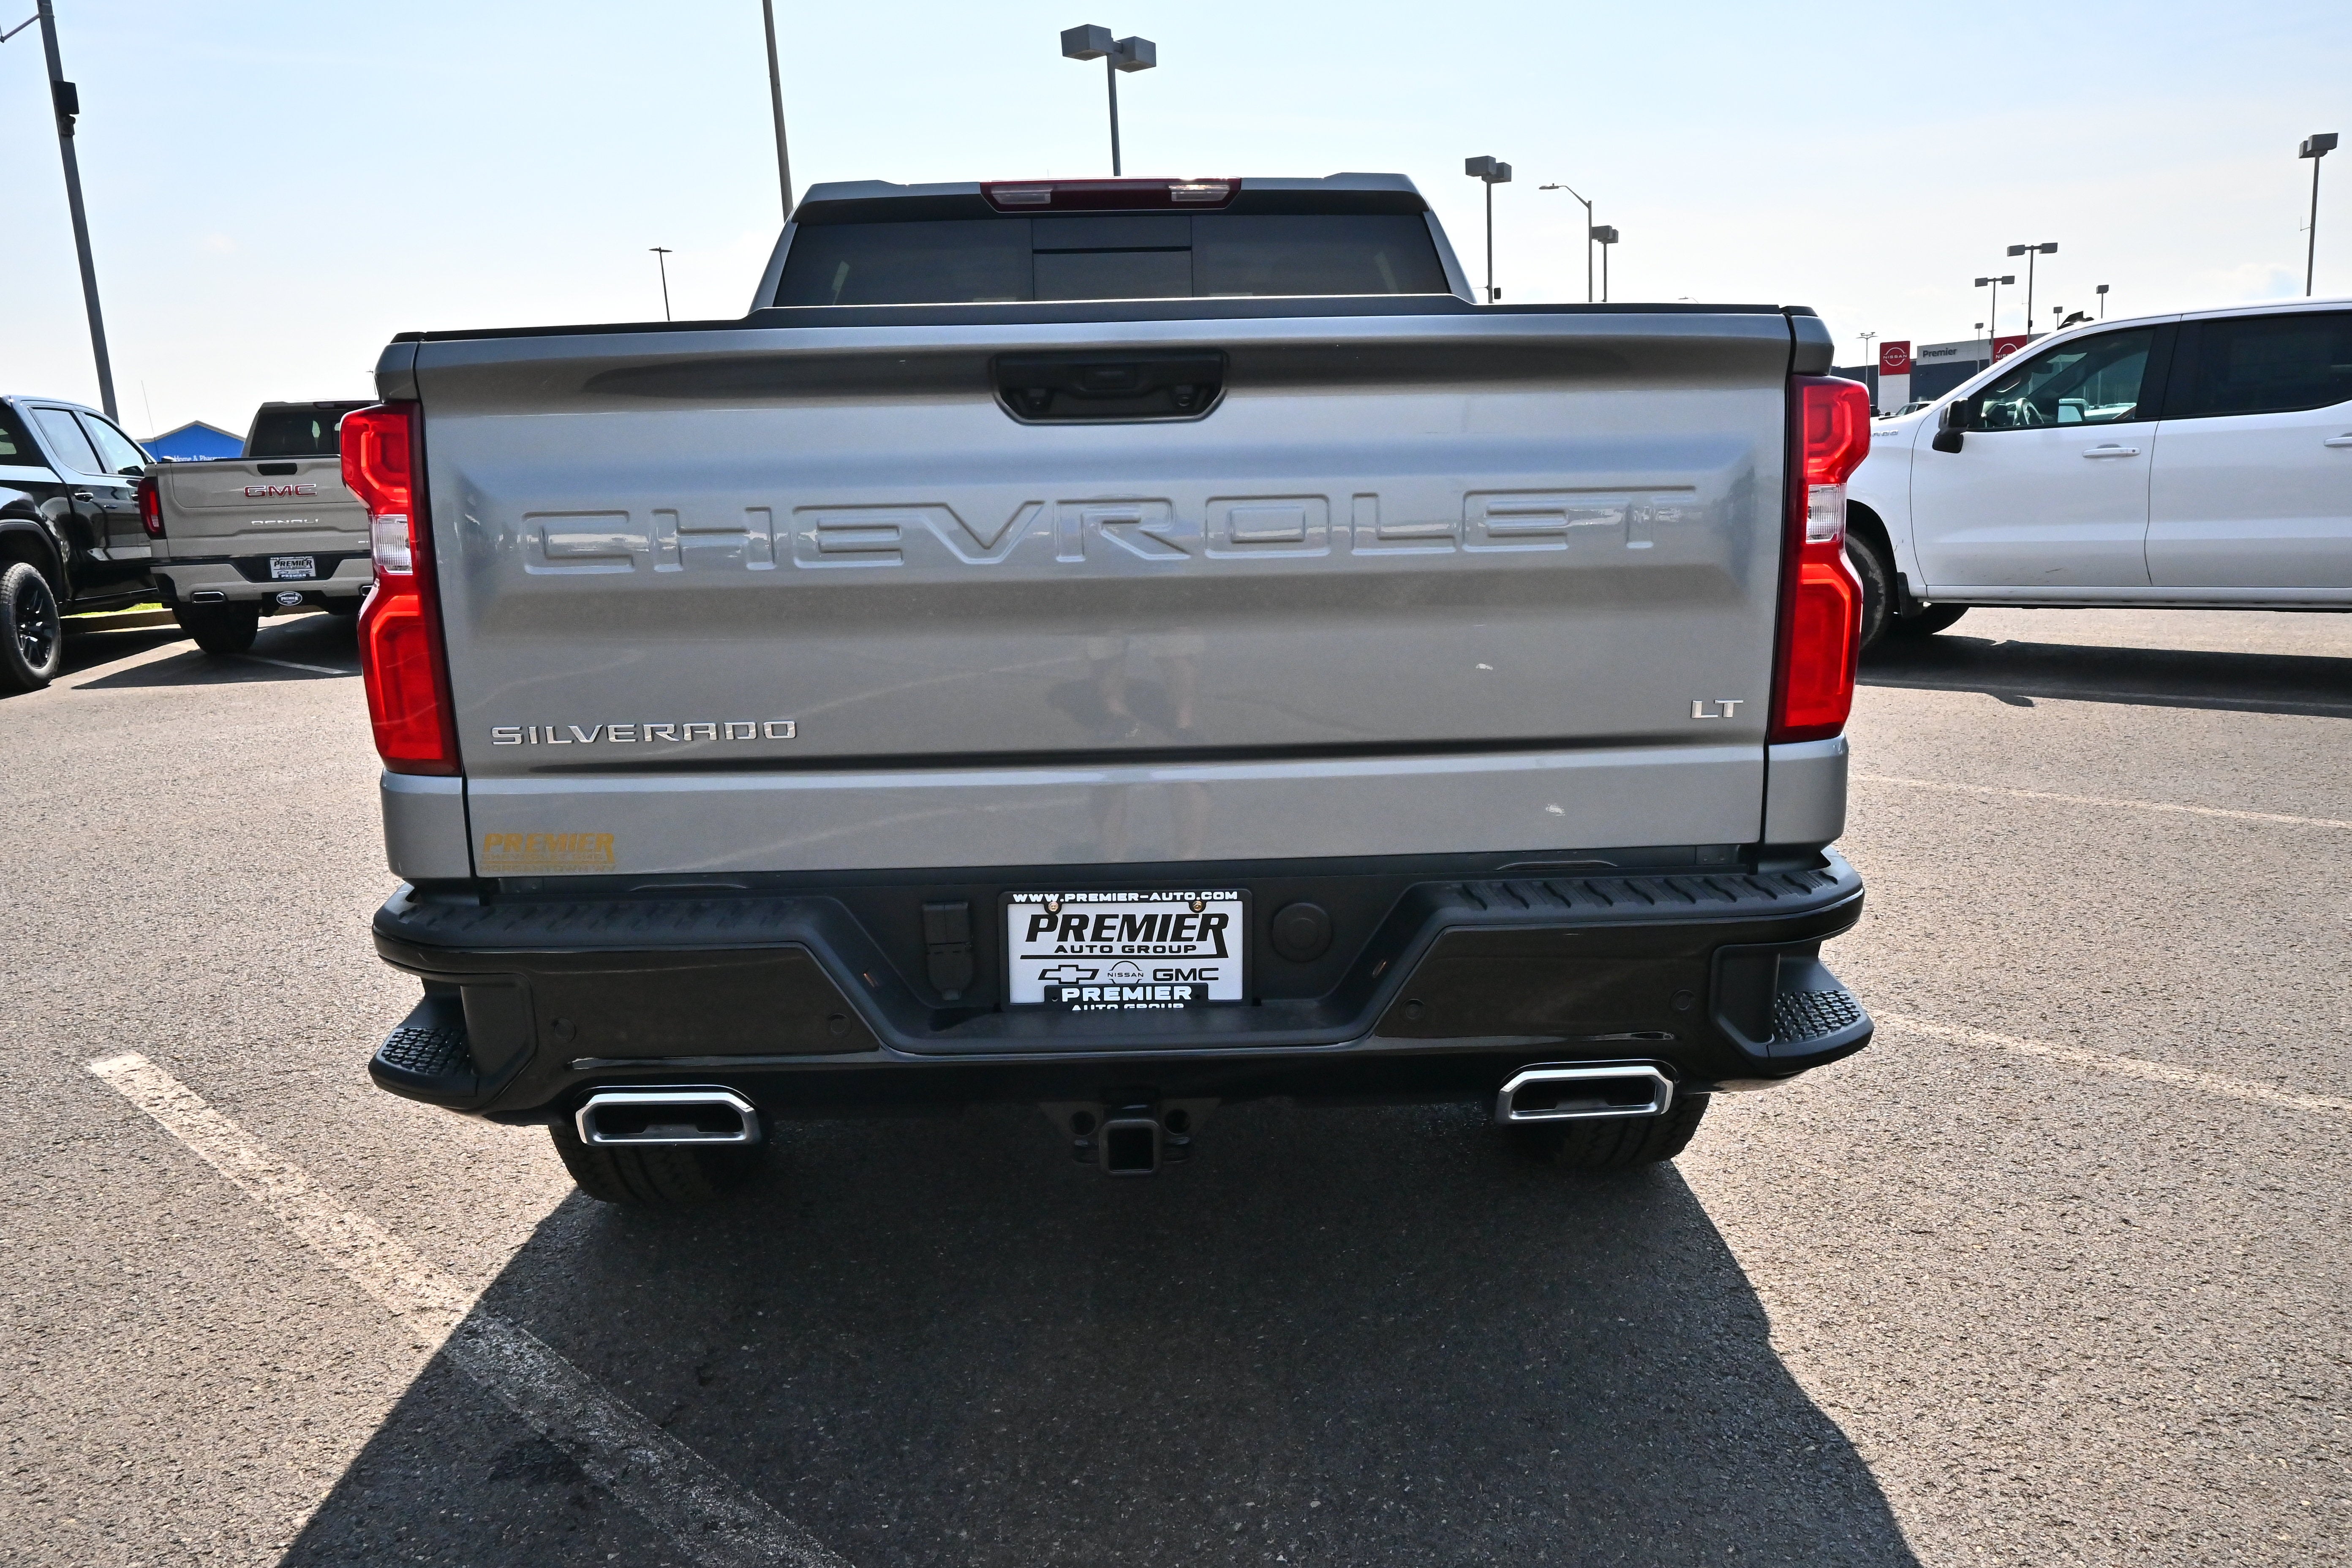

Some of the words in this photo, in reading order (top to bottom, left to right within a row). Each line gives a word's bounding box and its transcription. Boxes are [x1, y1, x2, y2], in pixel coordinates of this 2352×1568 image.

[1922, 347, 1958, 358] Premier
[244, 483, 317, 498] GMC
[520, 485, 1697, 574] CHEVROLET
[274, 560, 313, 569] PREMIER
[1690, 699, 1744, 719] LT
[491, 720, 797, 746] SILVERADO
[483, 833, 615, 863] PREMIER
[1013, 891, 1238, 903] WWW.PREMIER-AUTO.COM
[1025, 913, 1230, 958] PREMIER
[1054, 945, 1113, 954] AUTO
[1121, 944, 1197, 953] GROUP
[1152, 967, 1219, 982] GMC
[1061, 985, 1192, 1002] PREMIER
